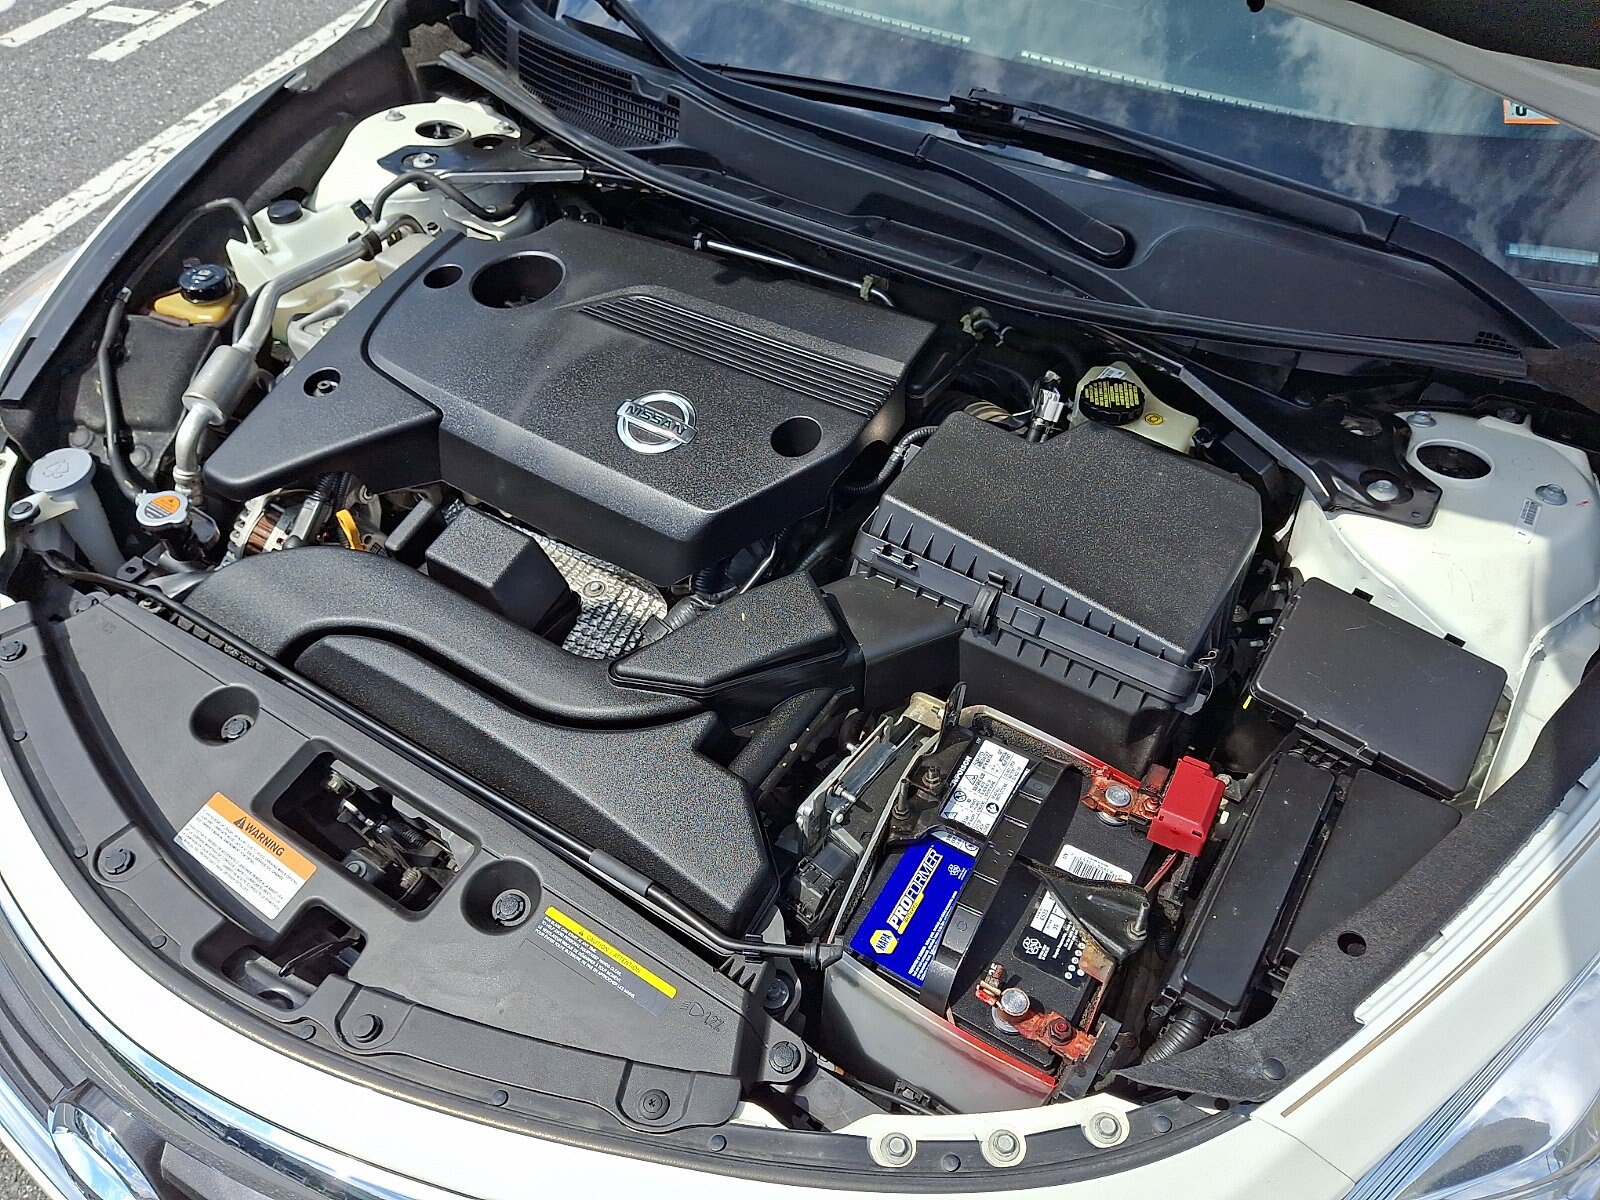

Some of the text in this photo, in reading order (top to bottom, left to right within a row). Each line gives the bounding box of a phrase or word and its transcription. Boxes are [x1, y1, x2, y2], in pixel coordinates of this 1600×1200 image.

[625, 405, 688, 435] NISSAN
[245, 822, 285, 857] WARNING
[890, 850, 942, 930] PROFORMER
[585, 934, 610, 952] CAUTION
[612, 952, 641, 974] ATTENTION
[875, 933, 893, 951] NAPA
